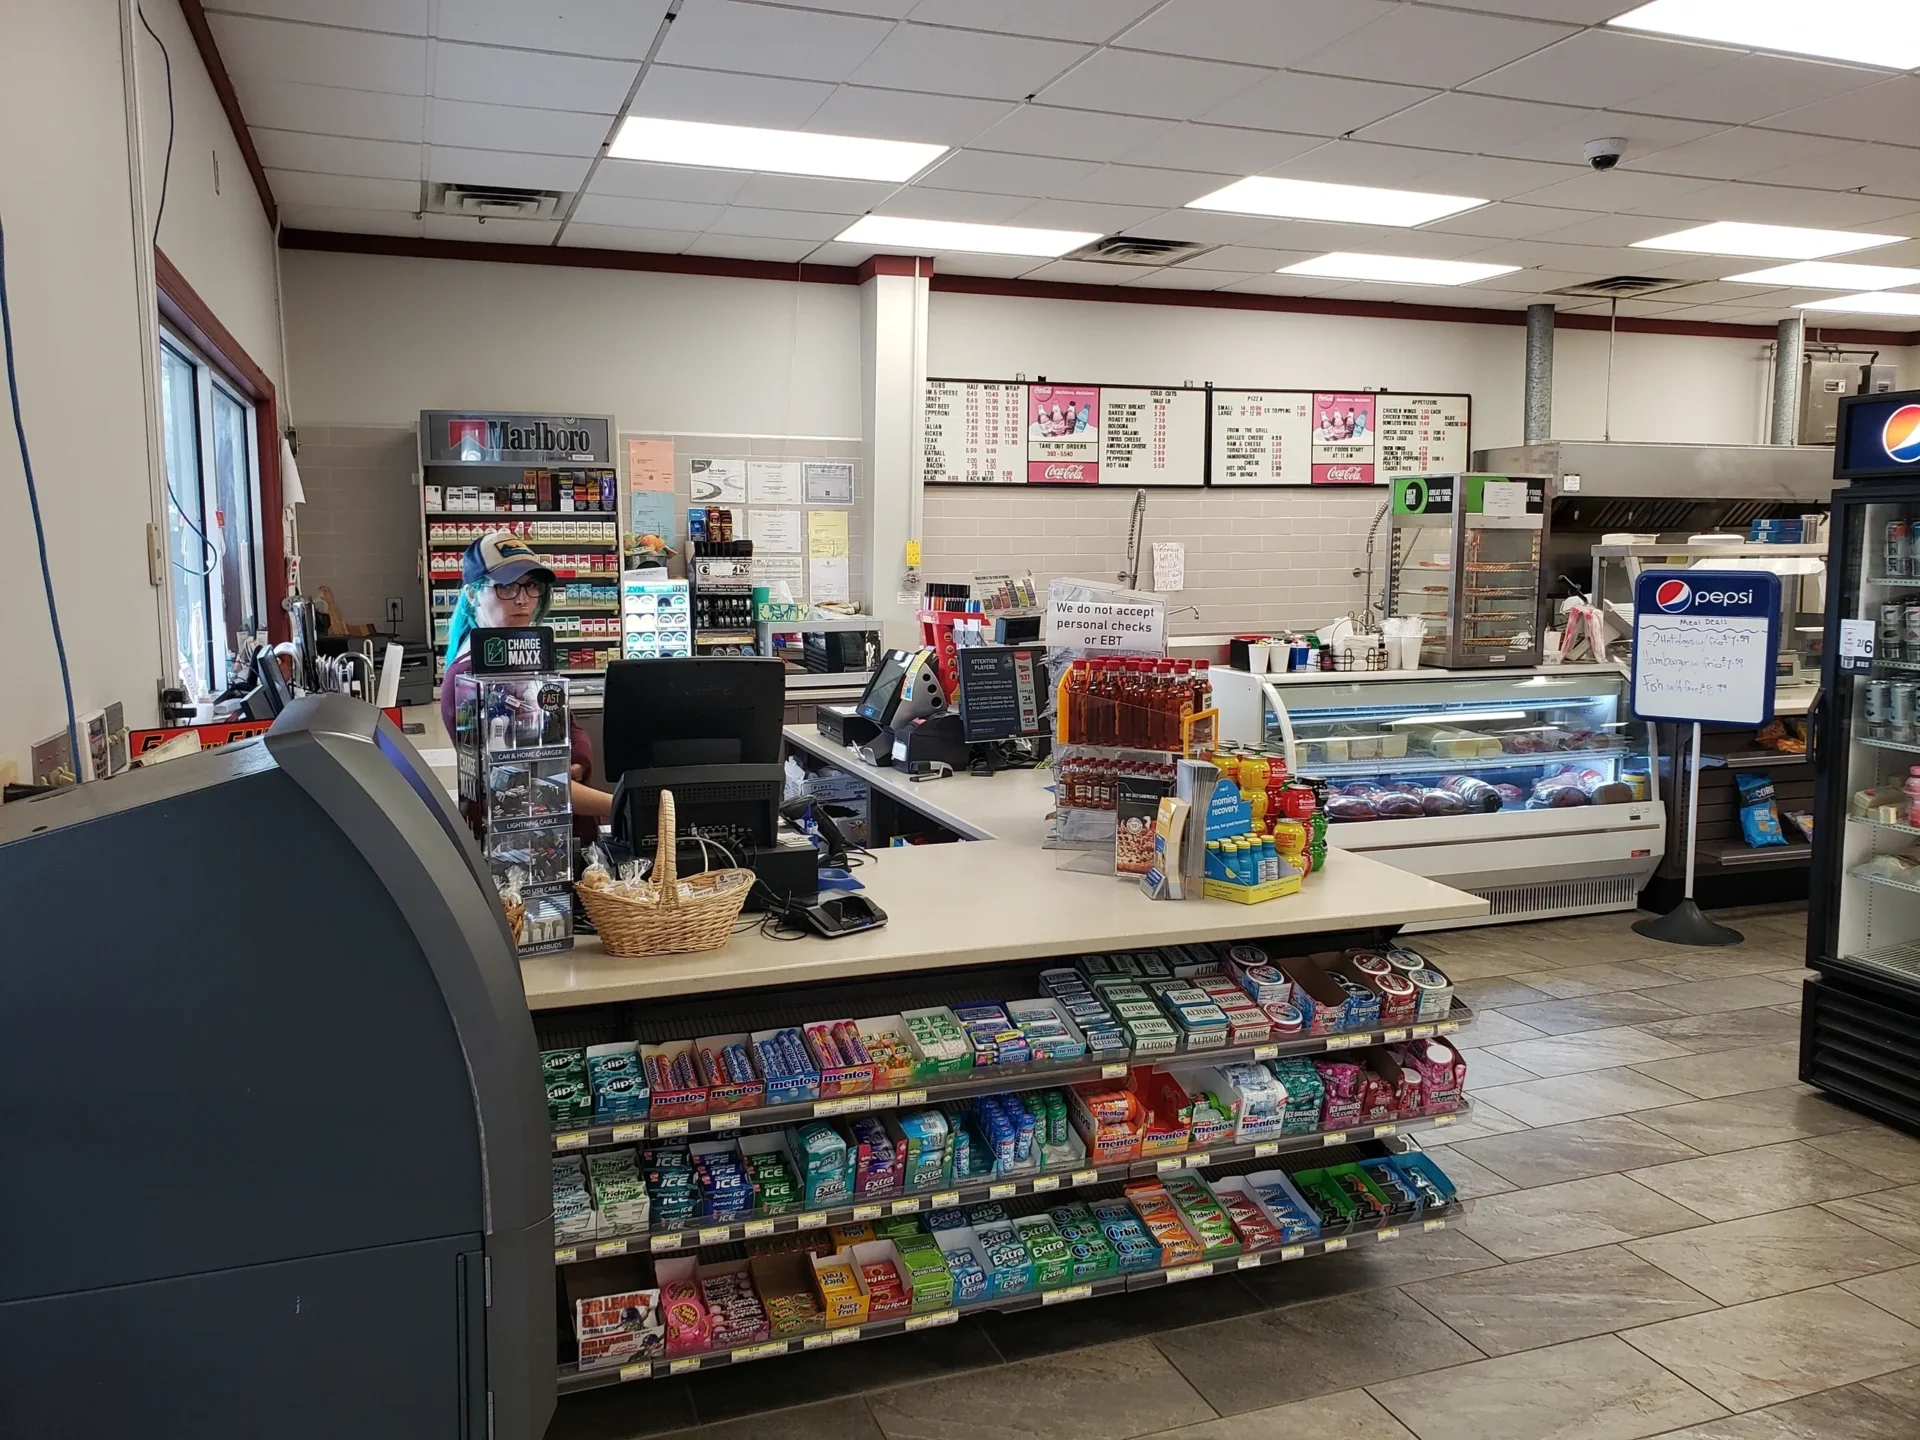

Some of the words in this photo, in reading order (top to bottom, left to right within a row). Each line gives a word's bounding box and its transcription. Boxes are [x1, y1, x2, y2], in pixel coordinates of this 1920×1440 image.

[488, 420, 591, 452] Marlboro
[1045, 464, 1084, 480] Coca-Cola
[1327, 466, 1362, 480] Coca-Cola
[1695, 589, 1753, 606] pepsi
[1056, 602, 1073, 613] We
[1076, 604, 1091, 614] do
[1094, 604, 1113, 615] not
[1116, 605, 1155, 618] accept
[1057, 619, 1108, 631] personal
[1112, 620, 1152, 632] checks
[508, 638, 541, 650] CHARGE
[1084, 636, 1096, 645] or
[1100, 635, 1123, 646] EBT
[508, 650, 541, 666] MAXX
[542, 684, 562, 693] PREMIUM
[542, 693, 560, 704] FAST
[517, 751, 535, 759] HOME
[536, 749, 563, 758] CHARGER
[459, 753, 476, 776] CHARGE
[460, 773, 477, 802] MAXX
[1212, 795, 1237, 807] morning
[1212, 805, 1239, 816] recovery.
[506, 820, 538, 829] LIGHTNING
[538, 817, 558, 825] CABLE
[532, 887, 543, 895] USB
[543, 884, 563, 893] CABLE
[1121, 1004, 1155, 1013] ALTOIDS
[1185, 1007, 1220, 1017] ALTOIDS
[1133, 1021, 1168, 1030] ALTOIDS
[594, 1055, 637, 1072] eclipse
[824, 1070, 871, 1082] mentos
[599, 1076, 642, 1094] eclipse
[770, 1075, 818, 1091] mentos
[711, 1085, 762, 1098] mentos
[654, 1092, 706, 1104] mentos
[1330, 1105, 1338, 1113] ICE
[1338, 1102, 1361, 1112] BREAKERS
[1194, 1122, 1234, 1134] mentos
[1147, 1130, 1188, 1141] mentos
[1098, 1137, 1140, 1148] mentos
[656, 1157, 682, 1167] ICE
[759, 1169, 784, 1179] ICE
[661, 1177, 688, 1187] ICE
[715, 1178, 741, 1189] ICE
[765, 1187, 789, 1196] ICE
[1137, 1200, 1166, 1210] Trident
[1190, 1211, 1217, 1220] Trident
[1106, 1225, 1141, 1242] Orbit
[1202, 1233, 1229, 1242] Trident
[903, 1243, 935, 1253] DOUBLEMINT
[1033, 1240, 1065, 1258] Extra
[1115, 1240, 1151, 1253] Orbit
[993, 1248, 1025, 1265] Extra
[913, 1266, 945, 1277] DOUBLEMINT
[918, 1291, 948, 1301] DOUBLEMINT
[582, 1301, 603, 1314] BIG
[604, 1294, 652, 1308] LEAGUE
[875, 1302, 890, 1311] Big
[890, 1299, 908, 1308] Red
[582, 1311, 621, 1327] CHEW
[582, 1327, 603, 1335] BUBBLE
[581, 1341, 596, 1349] BIG
[597, 1334, 633, 1346] LEAGUE
[582, 1346, 610, 1356] CHEW
